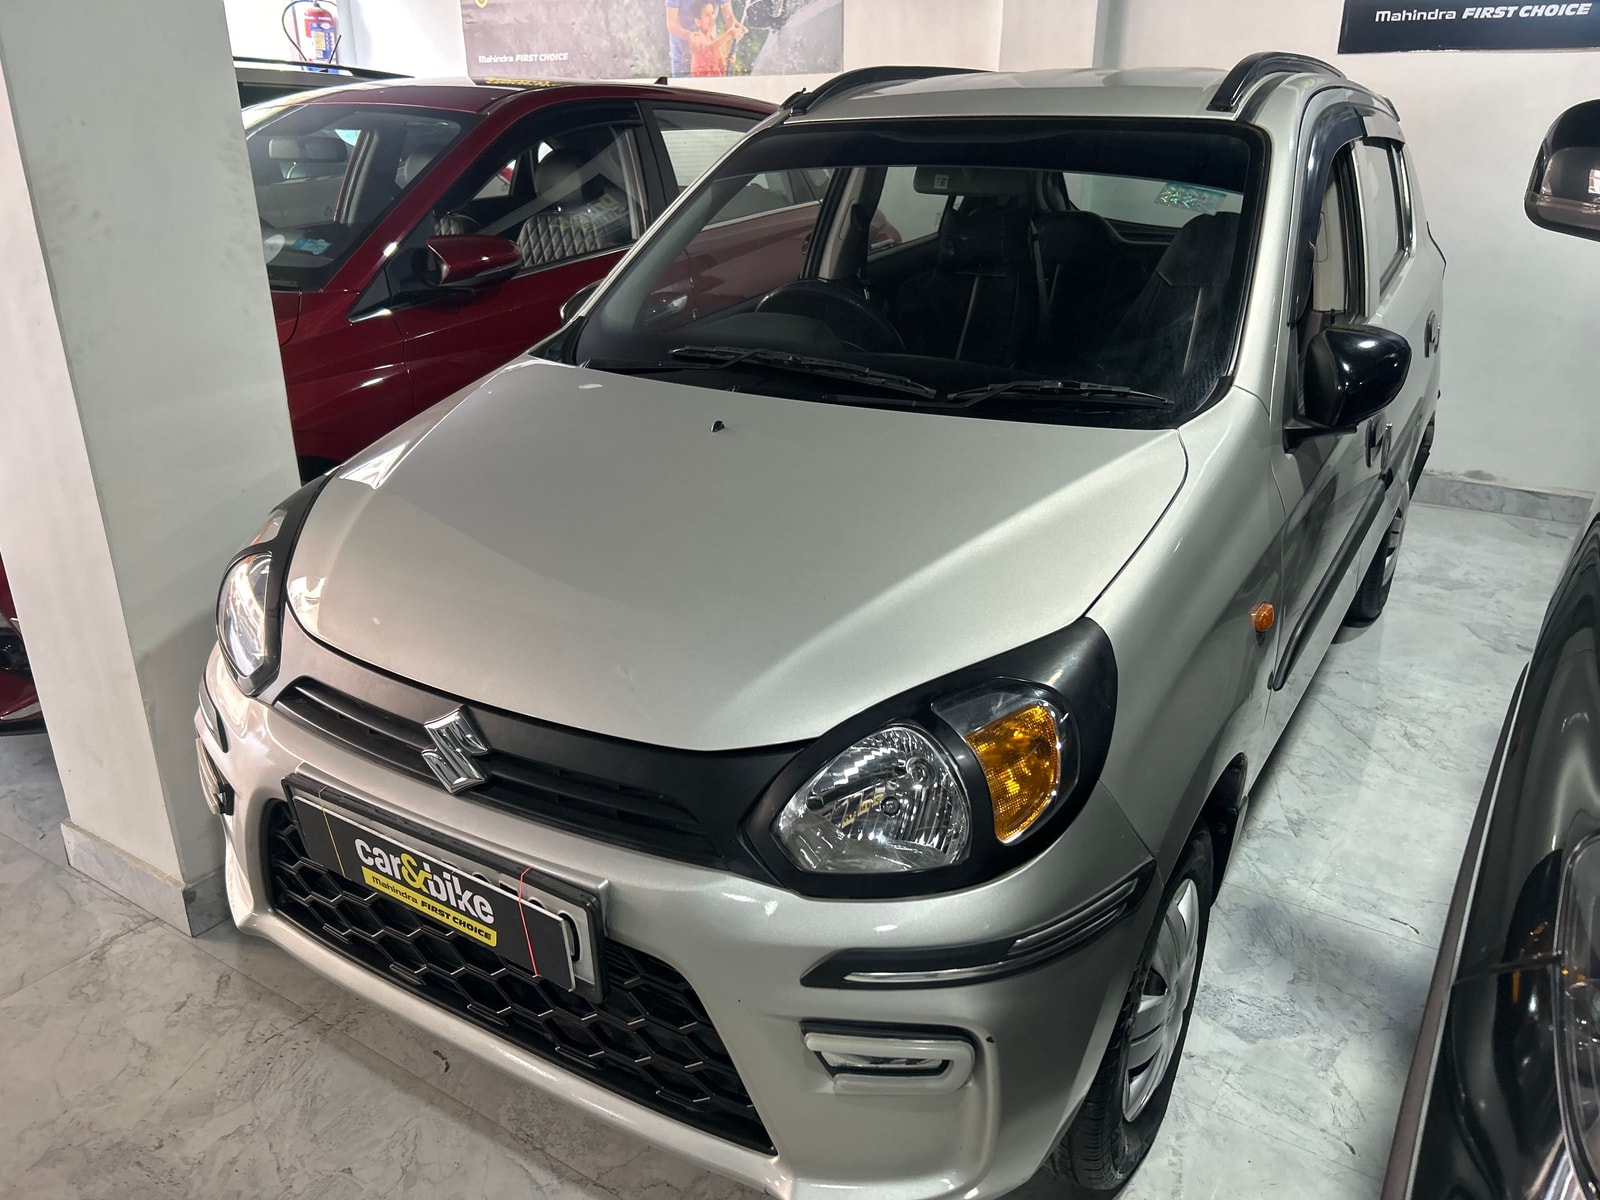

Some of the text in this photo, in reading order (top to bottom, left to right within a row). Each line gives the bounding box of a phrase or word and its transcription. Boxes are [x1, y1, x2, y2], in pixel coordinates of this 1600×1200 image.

[1375, 3, 1593, 23] Mahindra FIRST CHOICE
[478, 52, 569, 64] Mahindra FIRST CHOICE
[354, 838, 495, 925] car&bike
[371, 875, 493, 942] Mahindra FIRST CHOICE
